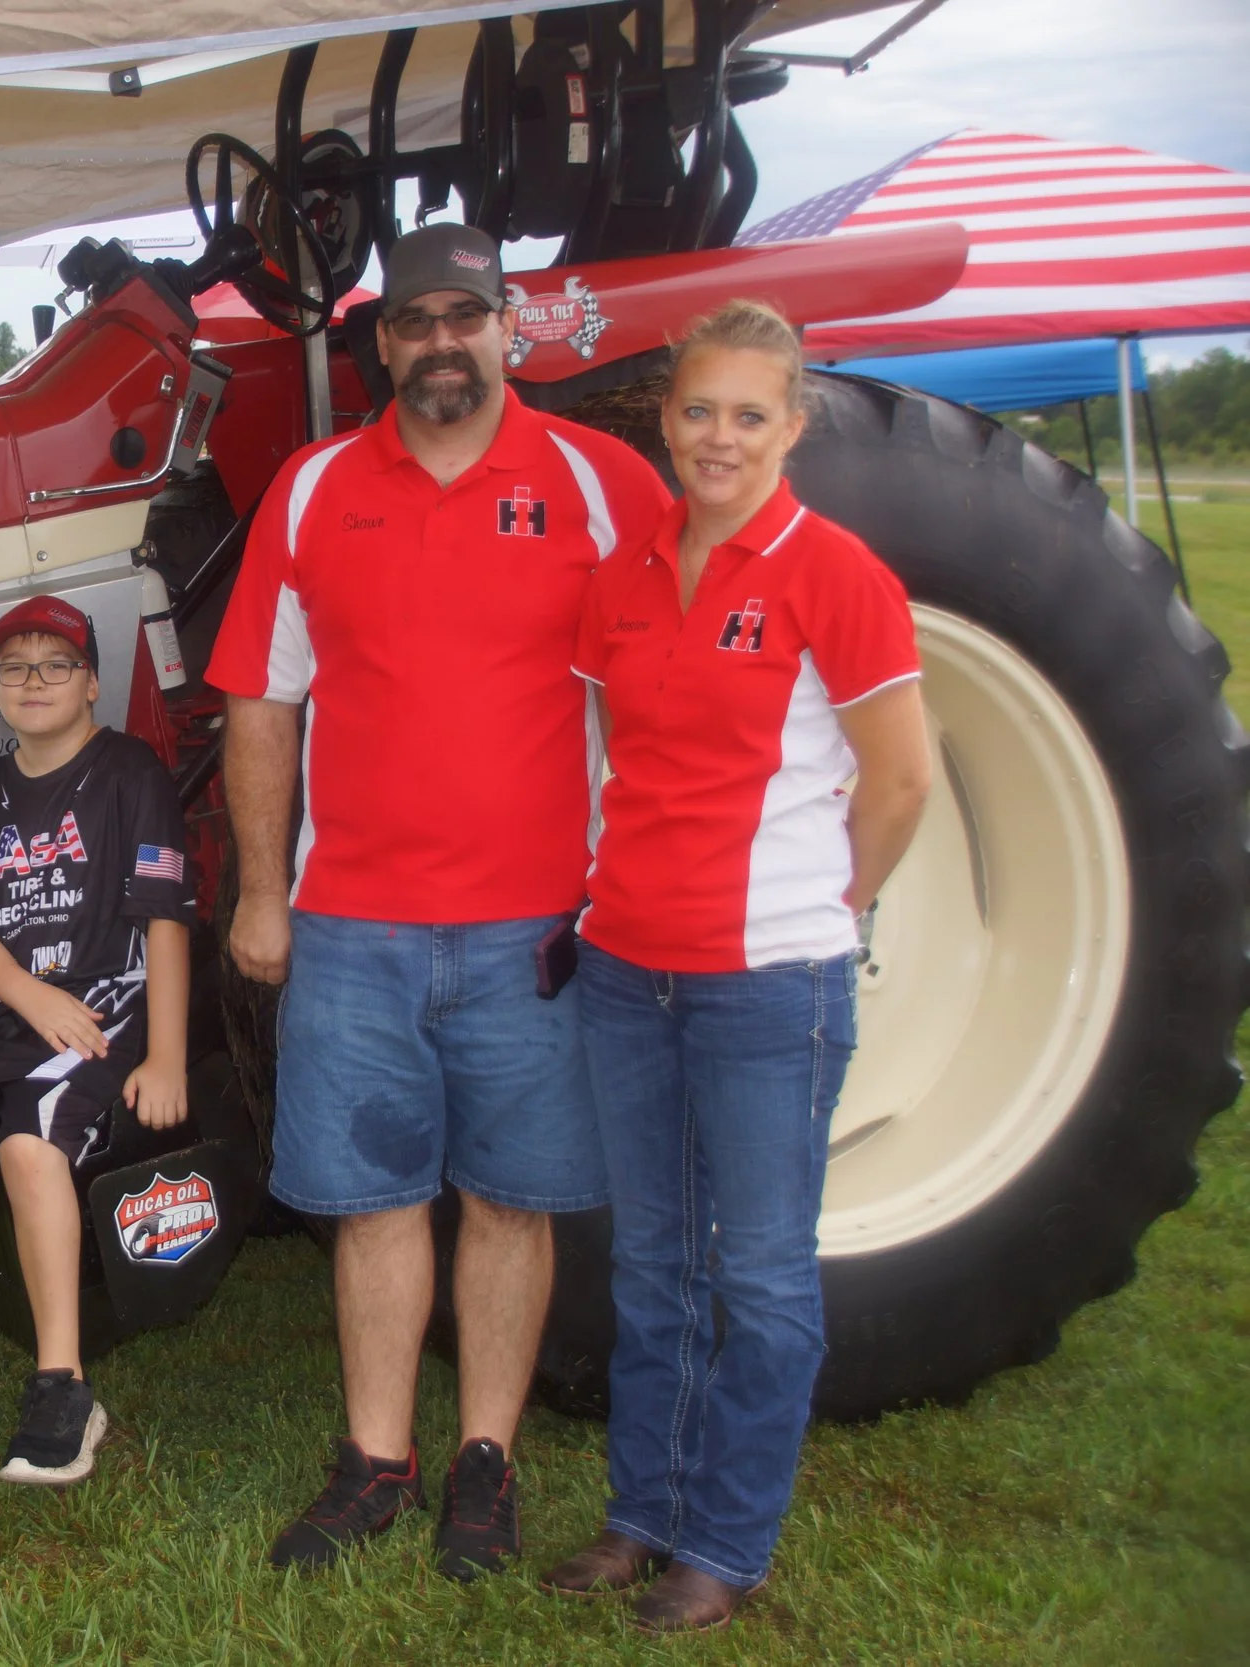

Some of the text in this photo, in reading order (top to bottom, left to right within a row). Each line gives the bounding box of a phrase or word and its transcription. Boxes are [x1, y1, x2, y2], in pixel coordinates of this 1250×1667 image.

[519, 303, 575, 323] FULL TILT
[342, 512, 385, 532] Shawn
[48, 913, 69, 924] OHIO
[125, 1182, 200, 1219] LUCAS OIL
[158, 1204, 204, 1234] PRO
[144, 1218, 215, 1248] PULLING
[156, 1230, 202, 1253] LEAGUE
